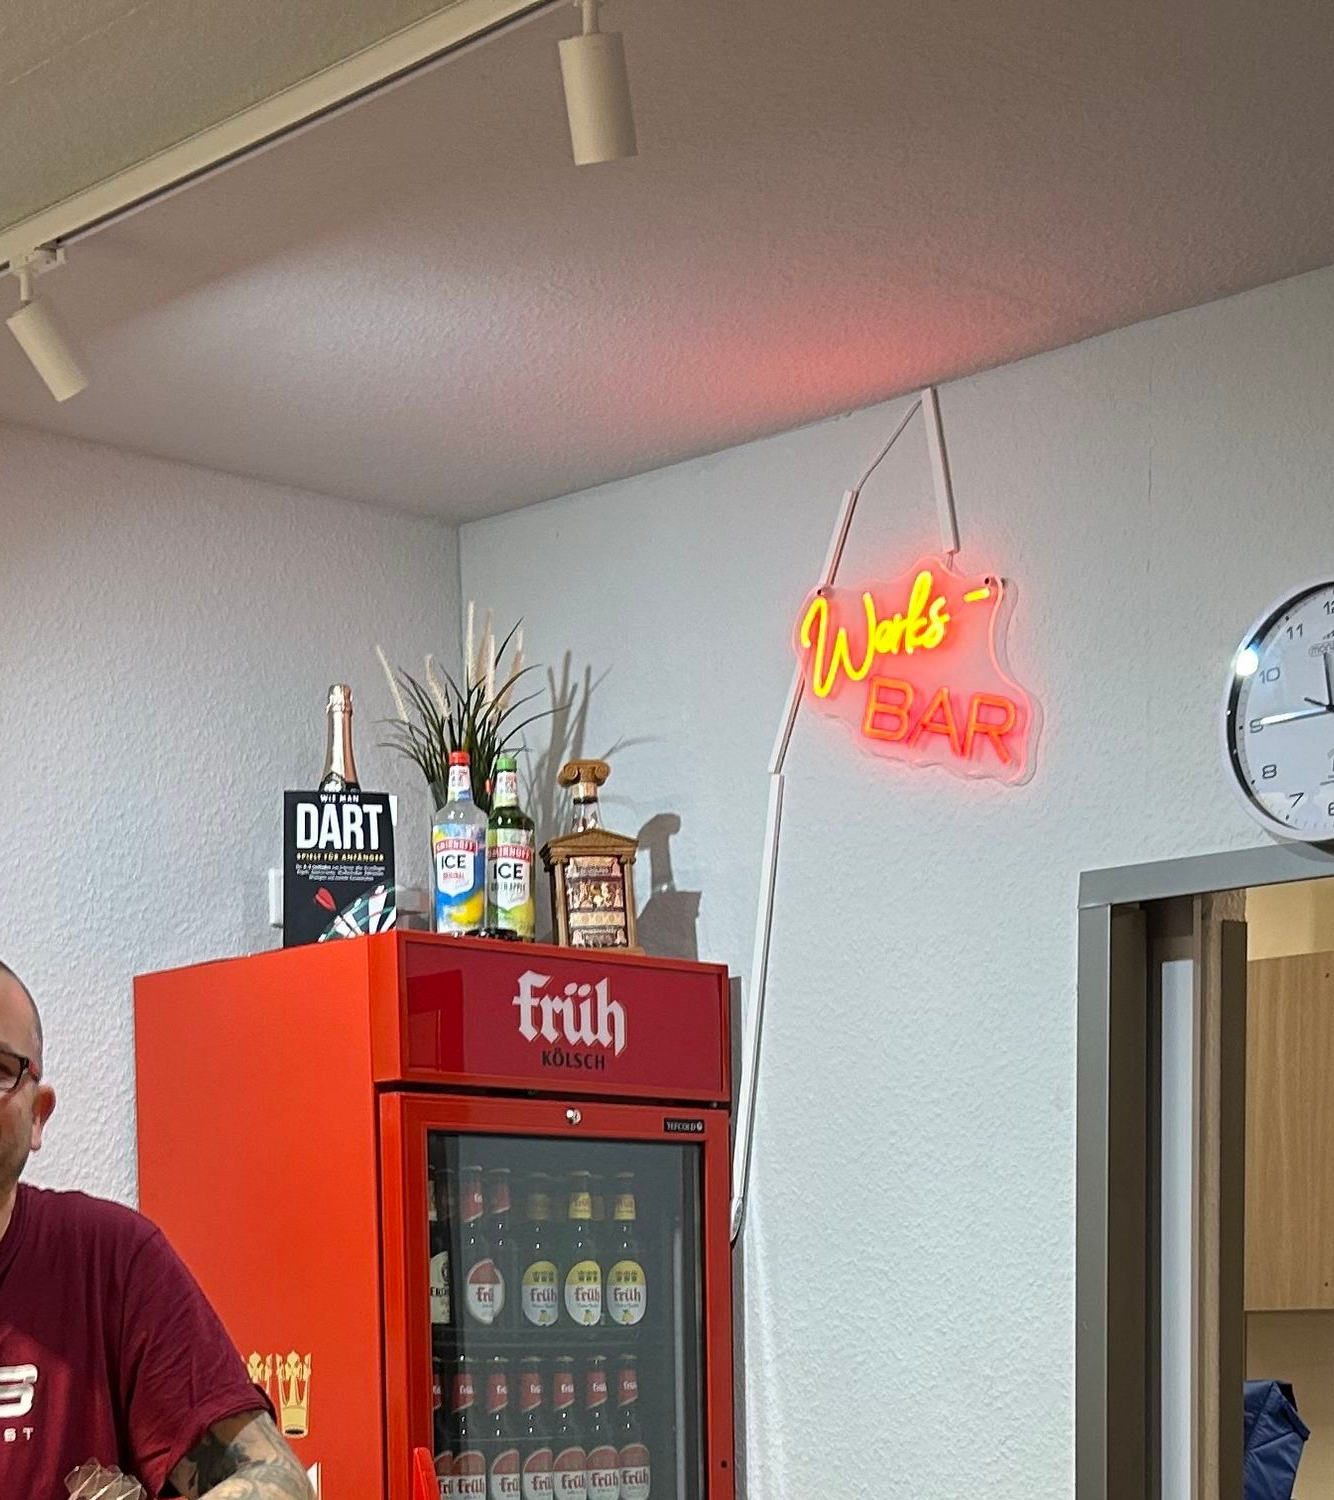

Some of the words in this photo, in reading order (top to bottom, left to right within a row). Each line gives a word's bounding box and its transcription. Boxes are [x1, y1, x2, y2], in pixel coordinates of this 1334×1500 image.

[1286, 623, 1304, 640] 11
[1259, 666, 1281, 684] 10
[862, 675, 1017, 765] BAR
[1261, 764, 1278, 780] 8
[1288, 792, 1304, 808] 7
[296, 802, 384, 850] DART
[441, 853, 467, 870] ICE
[493, 862, 524, 880] ICE
[512, 970, 627, 1058] früh
[541, 1047, 606, 1071] KÖLSCH
